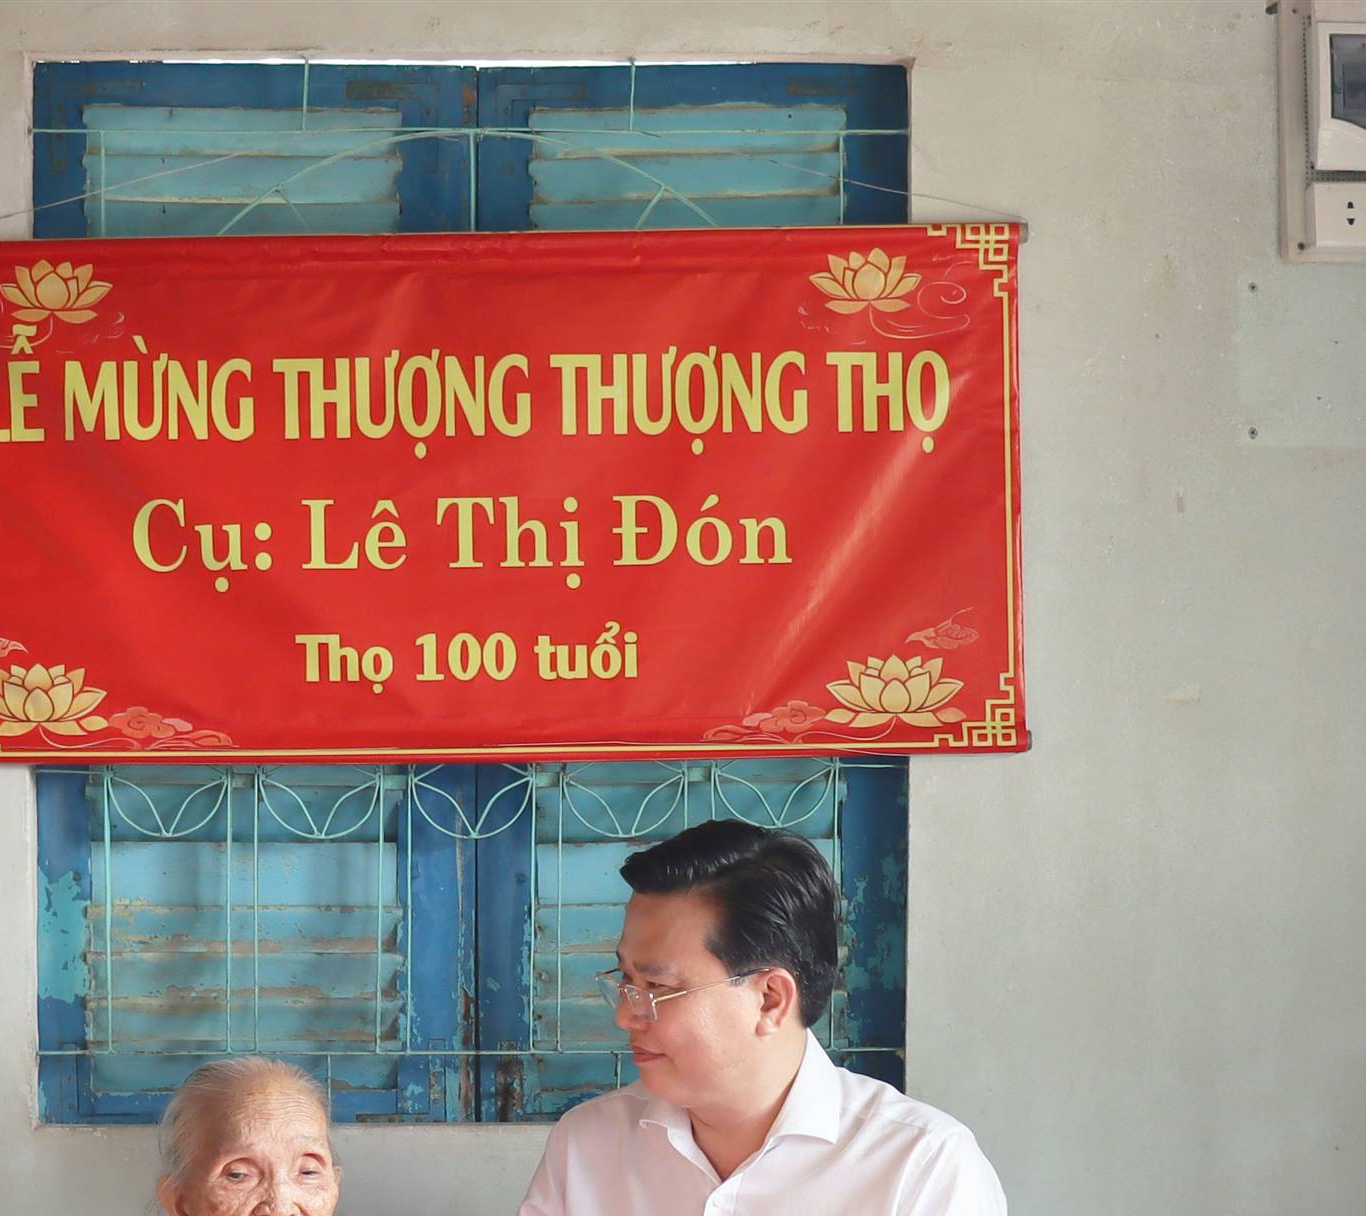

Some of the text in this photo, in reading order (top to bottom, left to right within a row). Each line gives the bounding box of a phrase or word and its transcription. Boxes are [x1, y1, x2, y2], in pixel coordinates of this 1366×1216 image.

[64, 335, 255, 442] MỪNG
[272, 349, 532, 459] THƯỢNG
[549, 345, 809, 456] THƯỢNG
[826, 350, 951, 454] THỌ
[131, 493, 793, 593] Cụ: Lê Thị Đón
[294, 620, 639, 695] Thọ 100 tuổi
